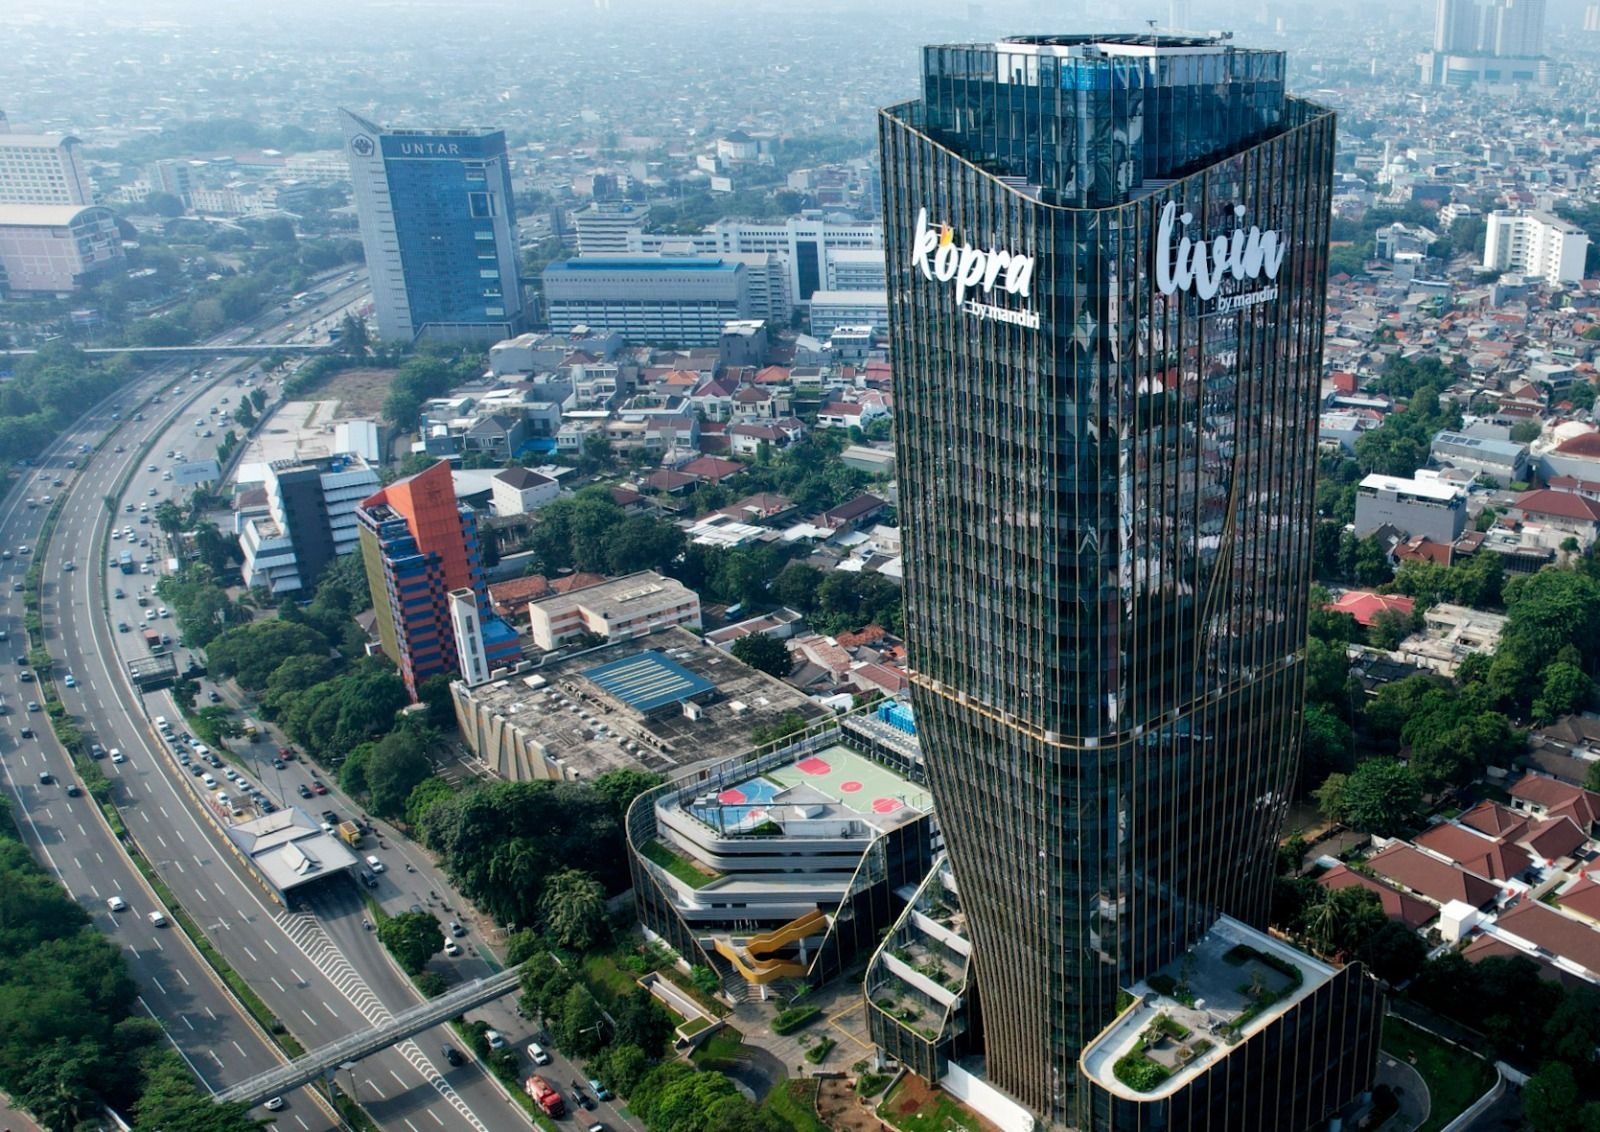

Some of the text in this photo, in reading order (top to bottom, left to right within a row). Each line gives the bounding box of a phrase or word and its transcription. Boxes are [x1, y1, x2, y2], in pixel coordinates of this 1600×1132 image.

[401, 143, 459, 154] UNTAR
[912, 207, 1034, 305] kopra
[1157, 200, 1285, 300] livin
[971, 298, 1040, 329] by mandiri
[1218, 284, 1278, 315] by mandiri
